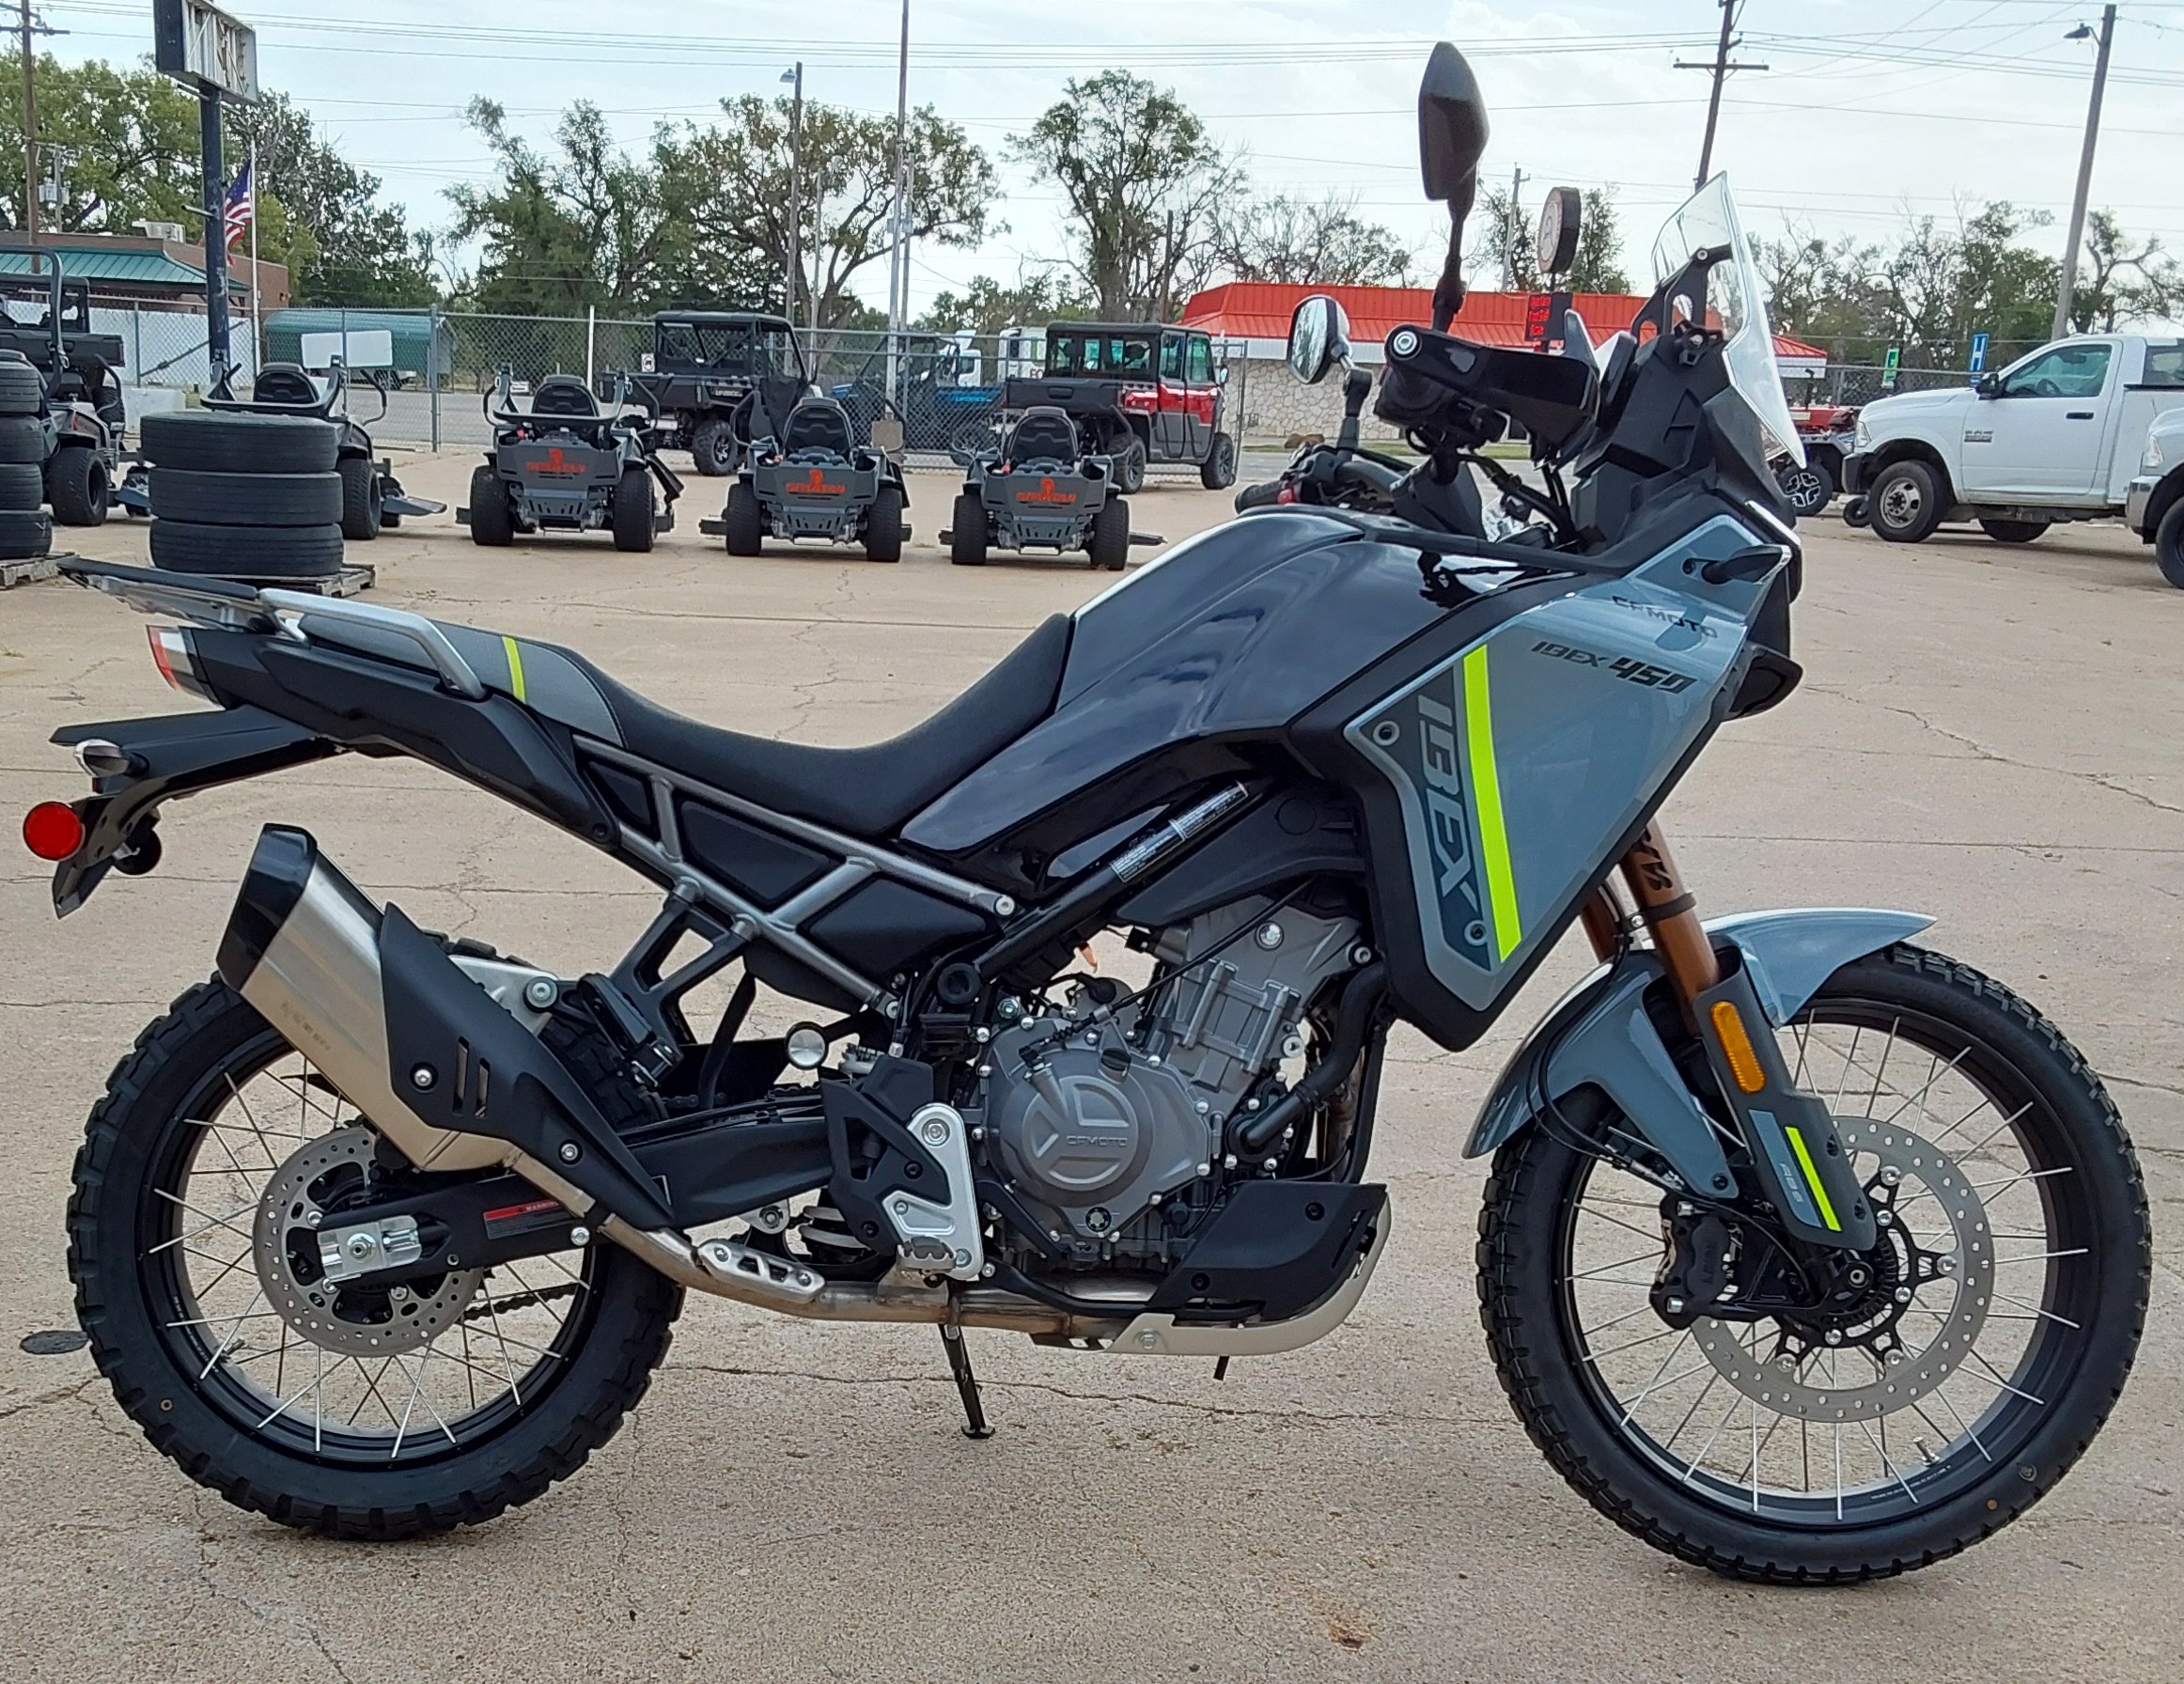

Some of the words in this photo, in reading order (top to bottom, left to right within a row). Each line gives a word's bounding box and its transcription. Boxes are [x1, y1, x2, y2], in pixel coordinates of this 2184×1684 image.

[1970, 337, 1986, 370] H
[1612, 595, 1718, 639] CFMOTO
[1531, 641, 1608, 667] IBEX
[1608, 657, 1698, 694] 450
[1418, 694, 1478, 913] IBEX
[1066, 1135, 1128, 1147] CFMOTO
